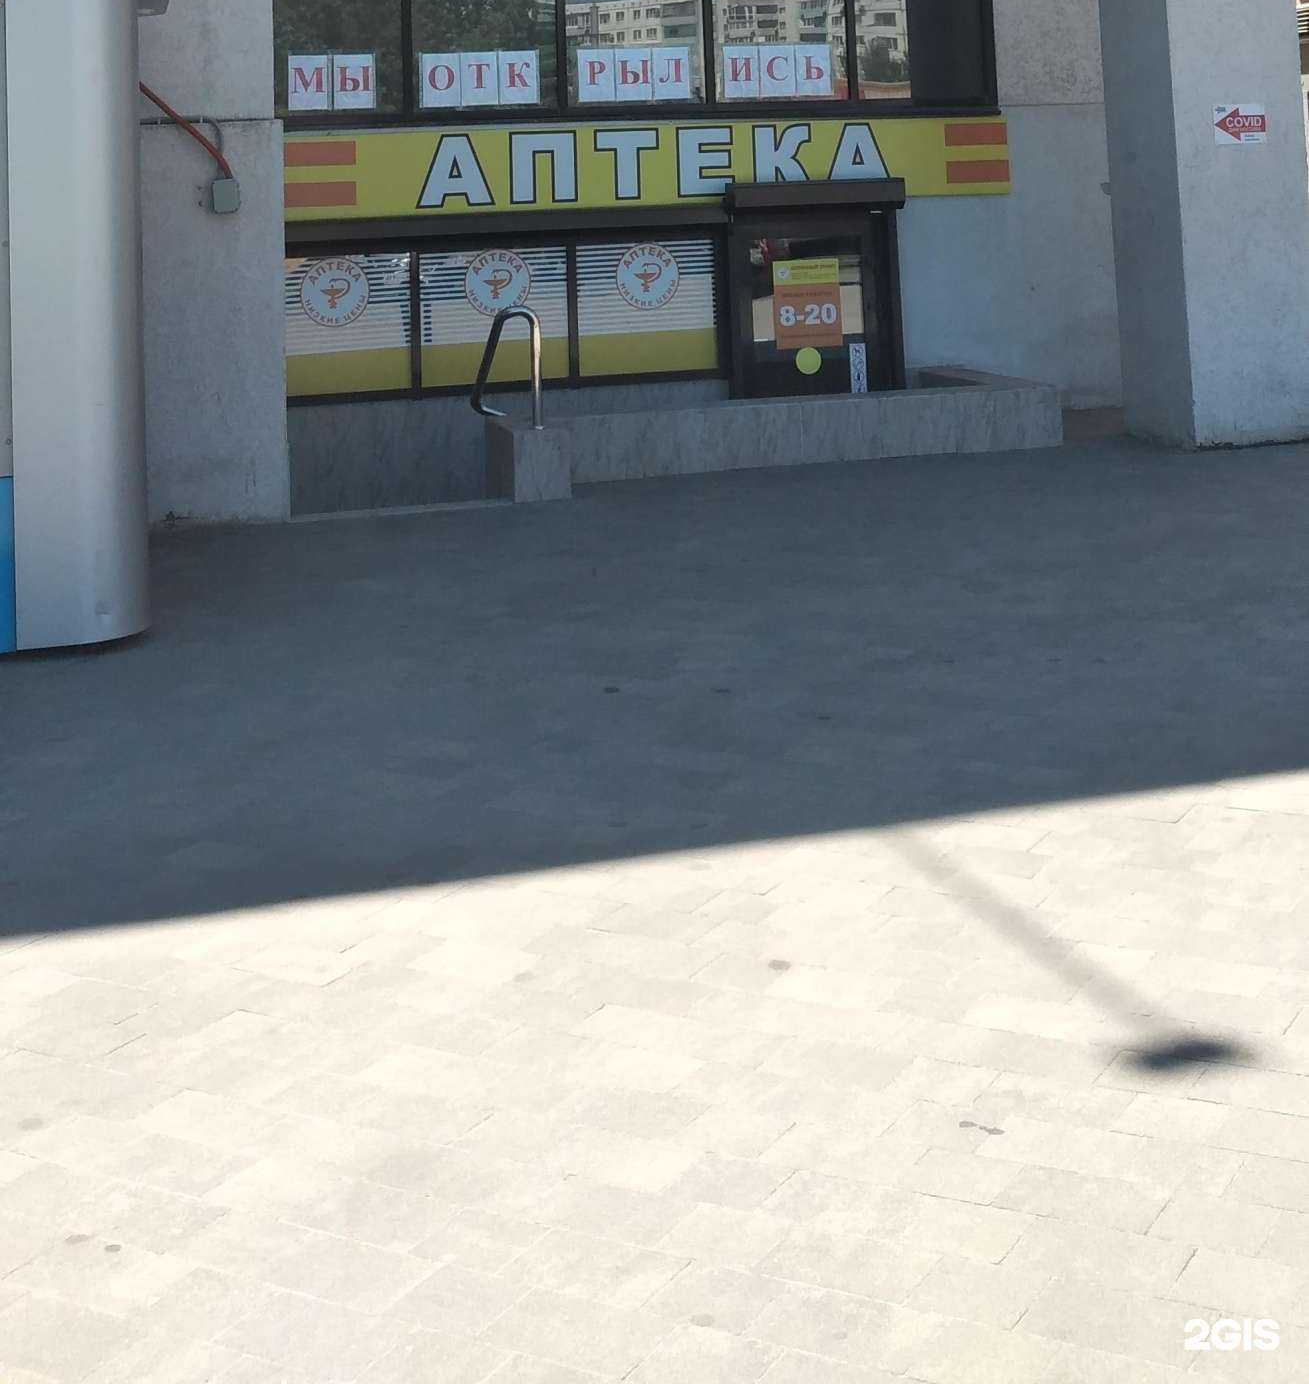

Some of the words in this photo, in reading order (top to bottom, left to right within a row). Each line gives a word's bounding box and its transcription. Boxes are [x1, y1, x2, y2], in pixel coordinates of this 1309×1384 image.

[291, 65, 374, 93] МЫ
[427, 61, 532, 92] ОТК
[585, 57, 684, 86] РЫЛ
[729, 54, 825, 82] ИСЬ
[1226, 117, 1262, 127] COVID
[415, 122, 891, 209] АПТЕКА
[472, 251, 523, 276] АПТЕКА
[623, 244, 673, 269] АПТЕКА
[308, 260, 362, 287] АПТЕКА
[779, 303, 837, 327] 8-20
